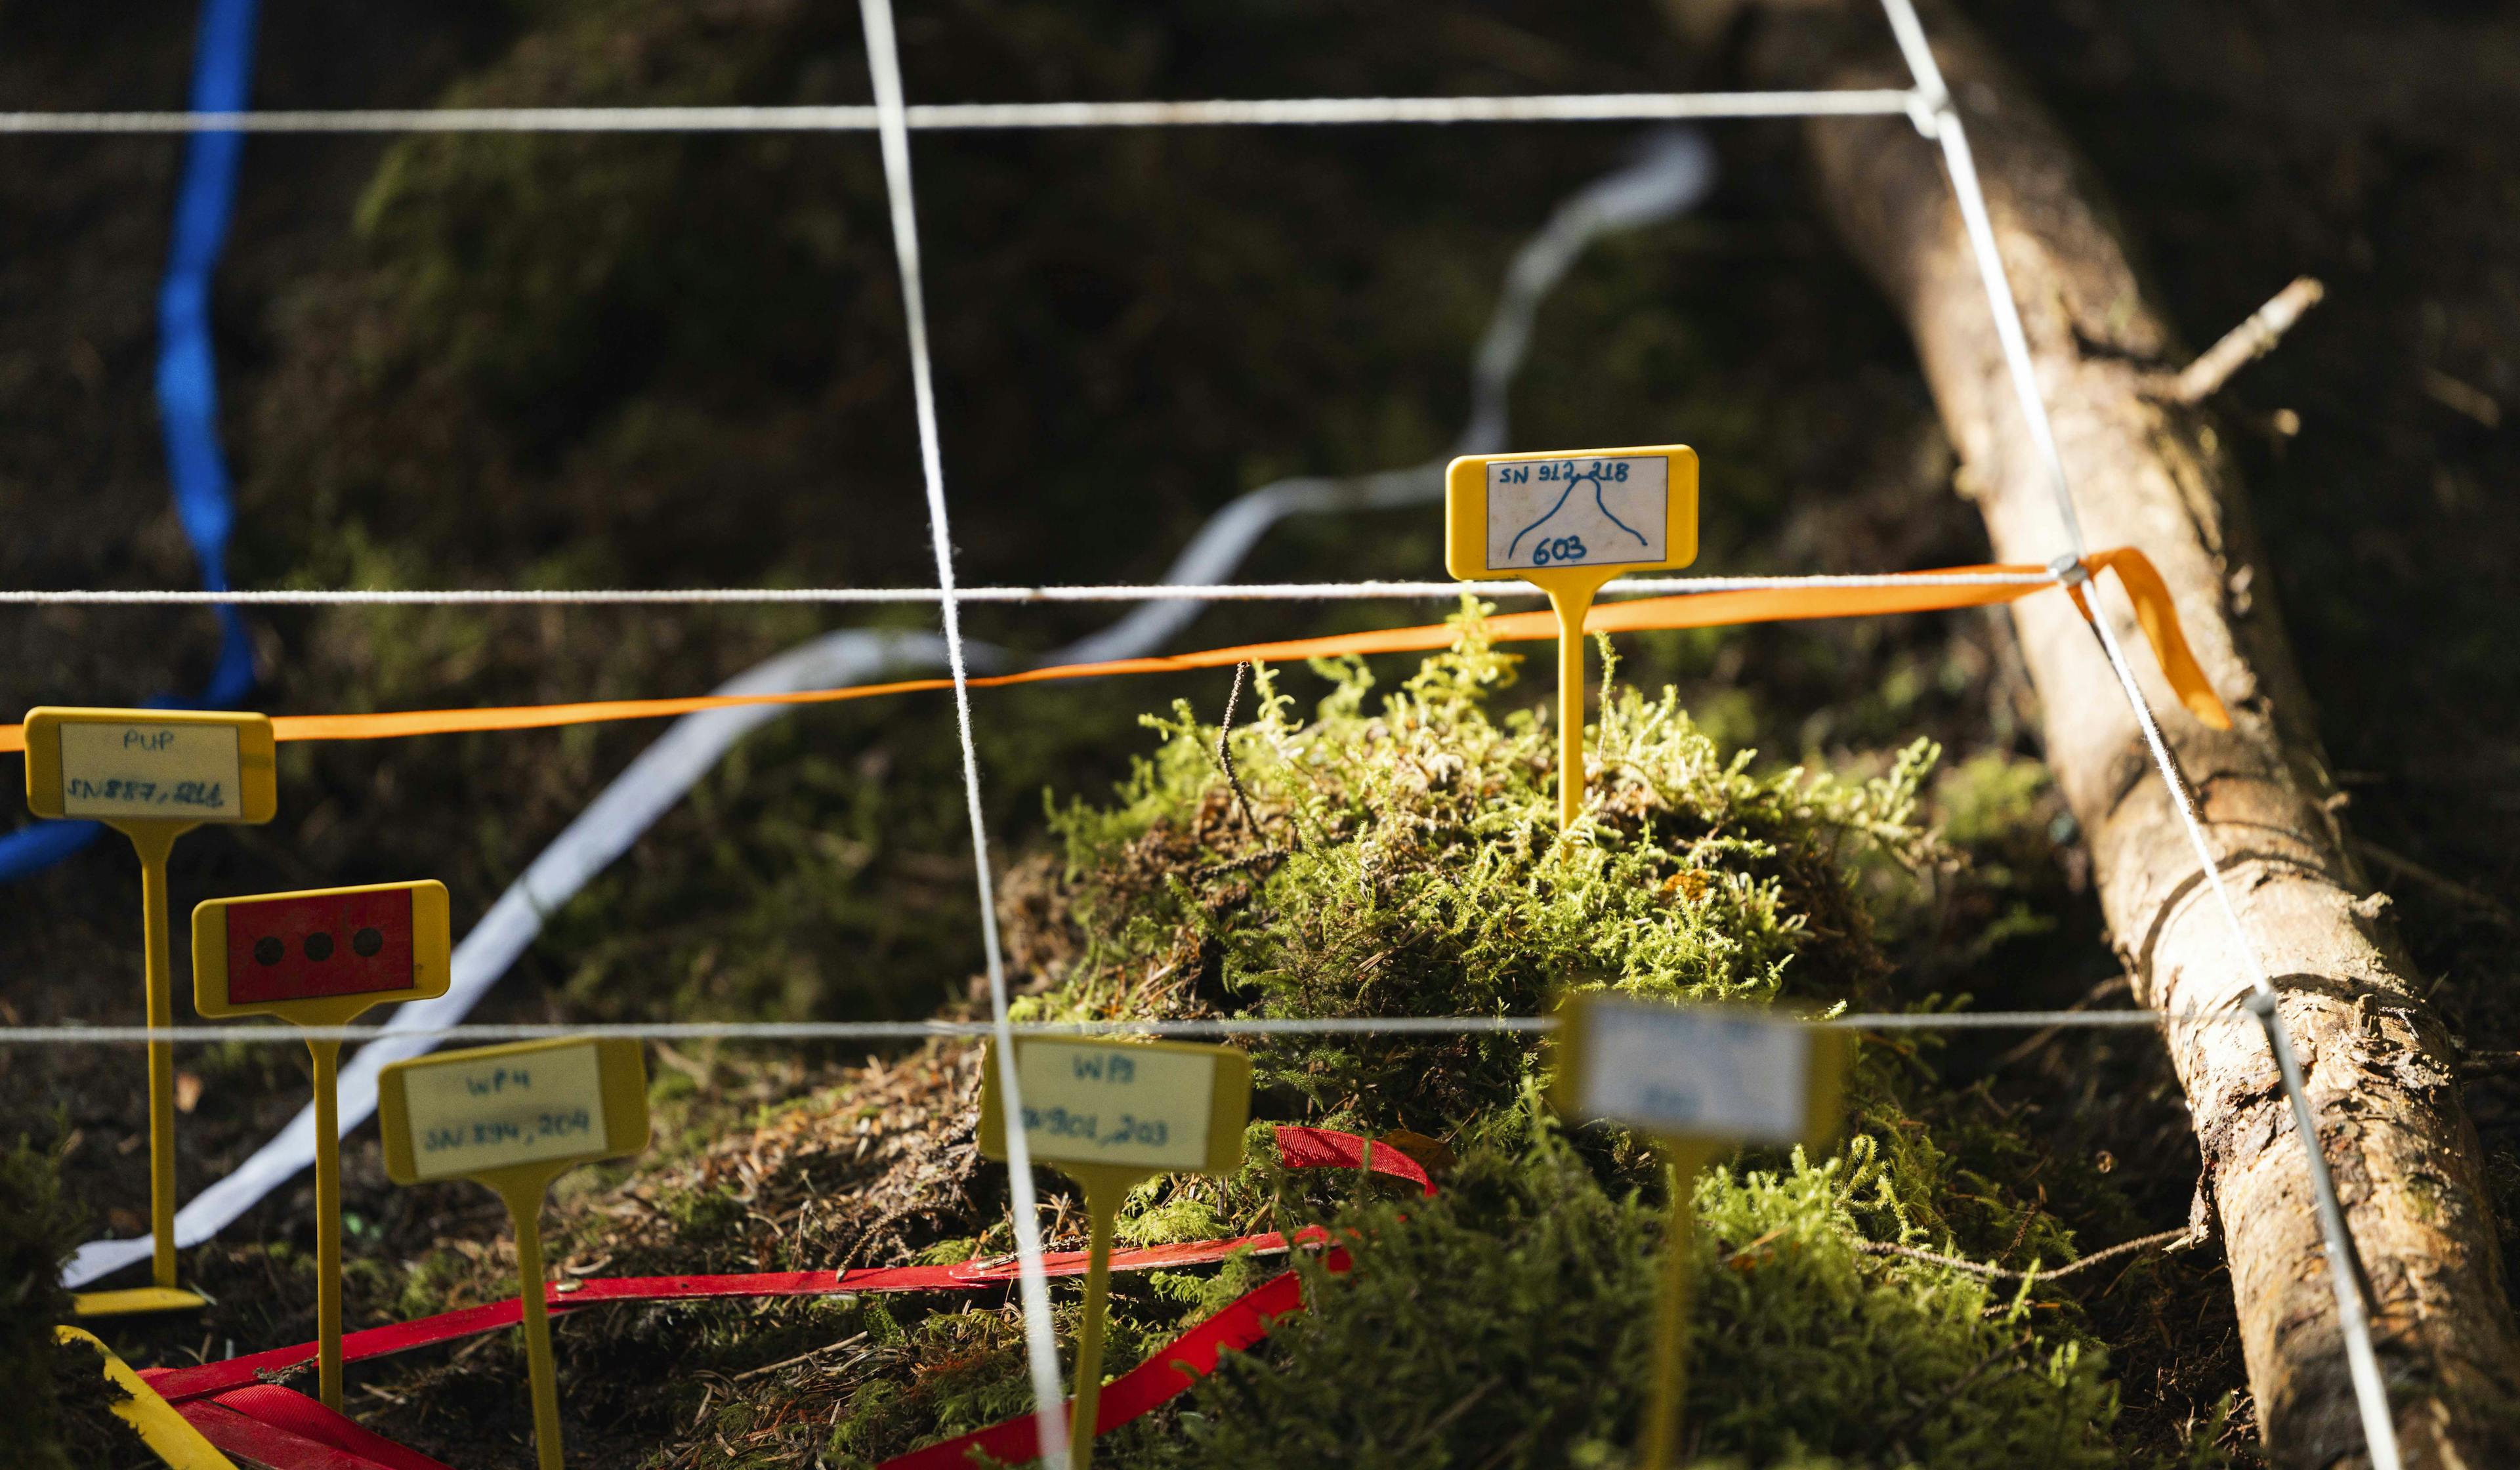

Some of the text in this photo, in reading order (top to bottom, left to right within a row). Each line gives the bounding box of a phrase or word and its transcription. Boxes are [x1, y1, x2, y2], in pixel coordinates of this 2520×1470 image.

[1499, 465, 1529, 484] SN
[1532, 535, 1587, 565] 603
[123, 728, 174, 751] PUP
